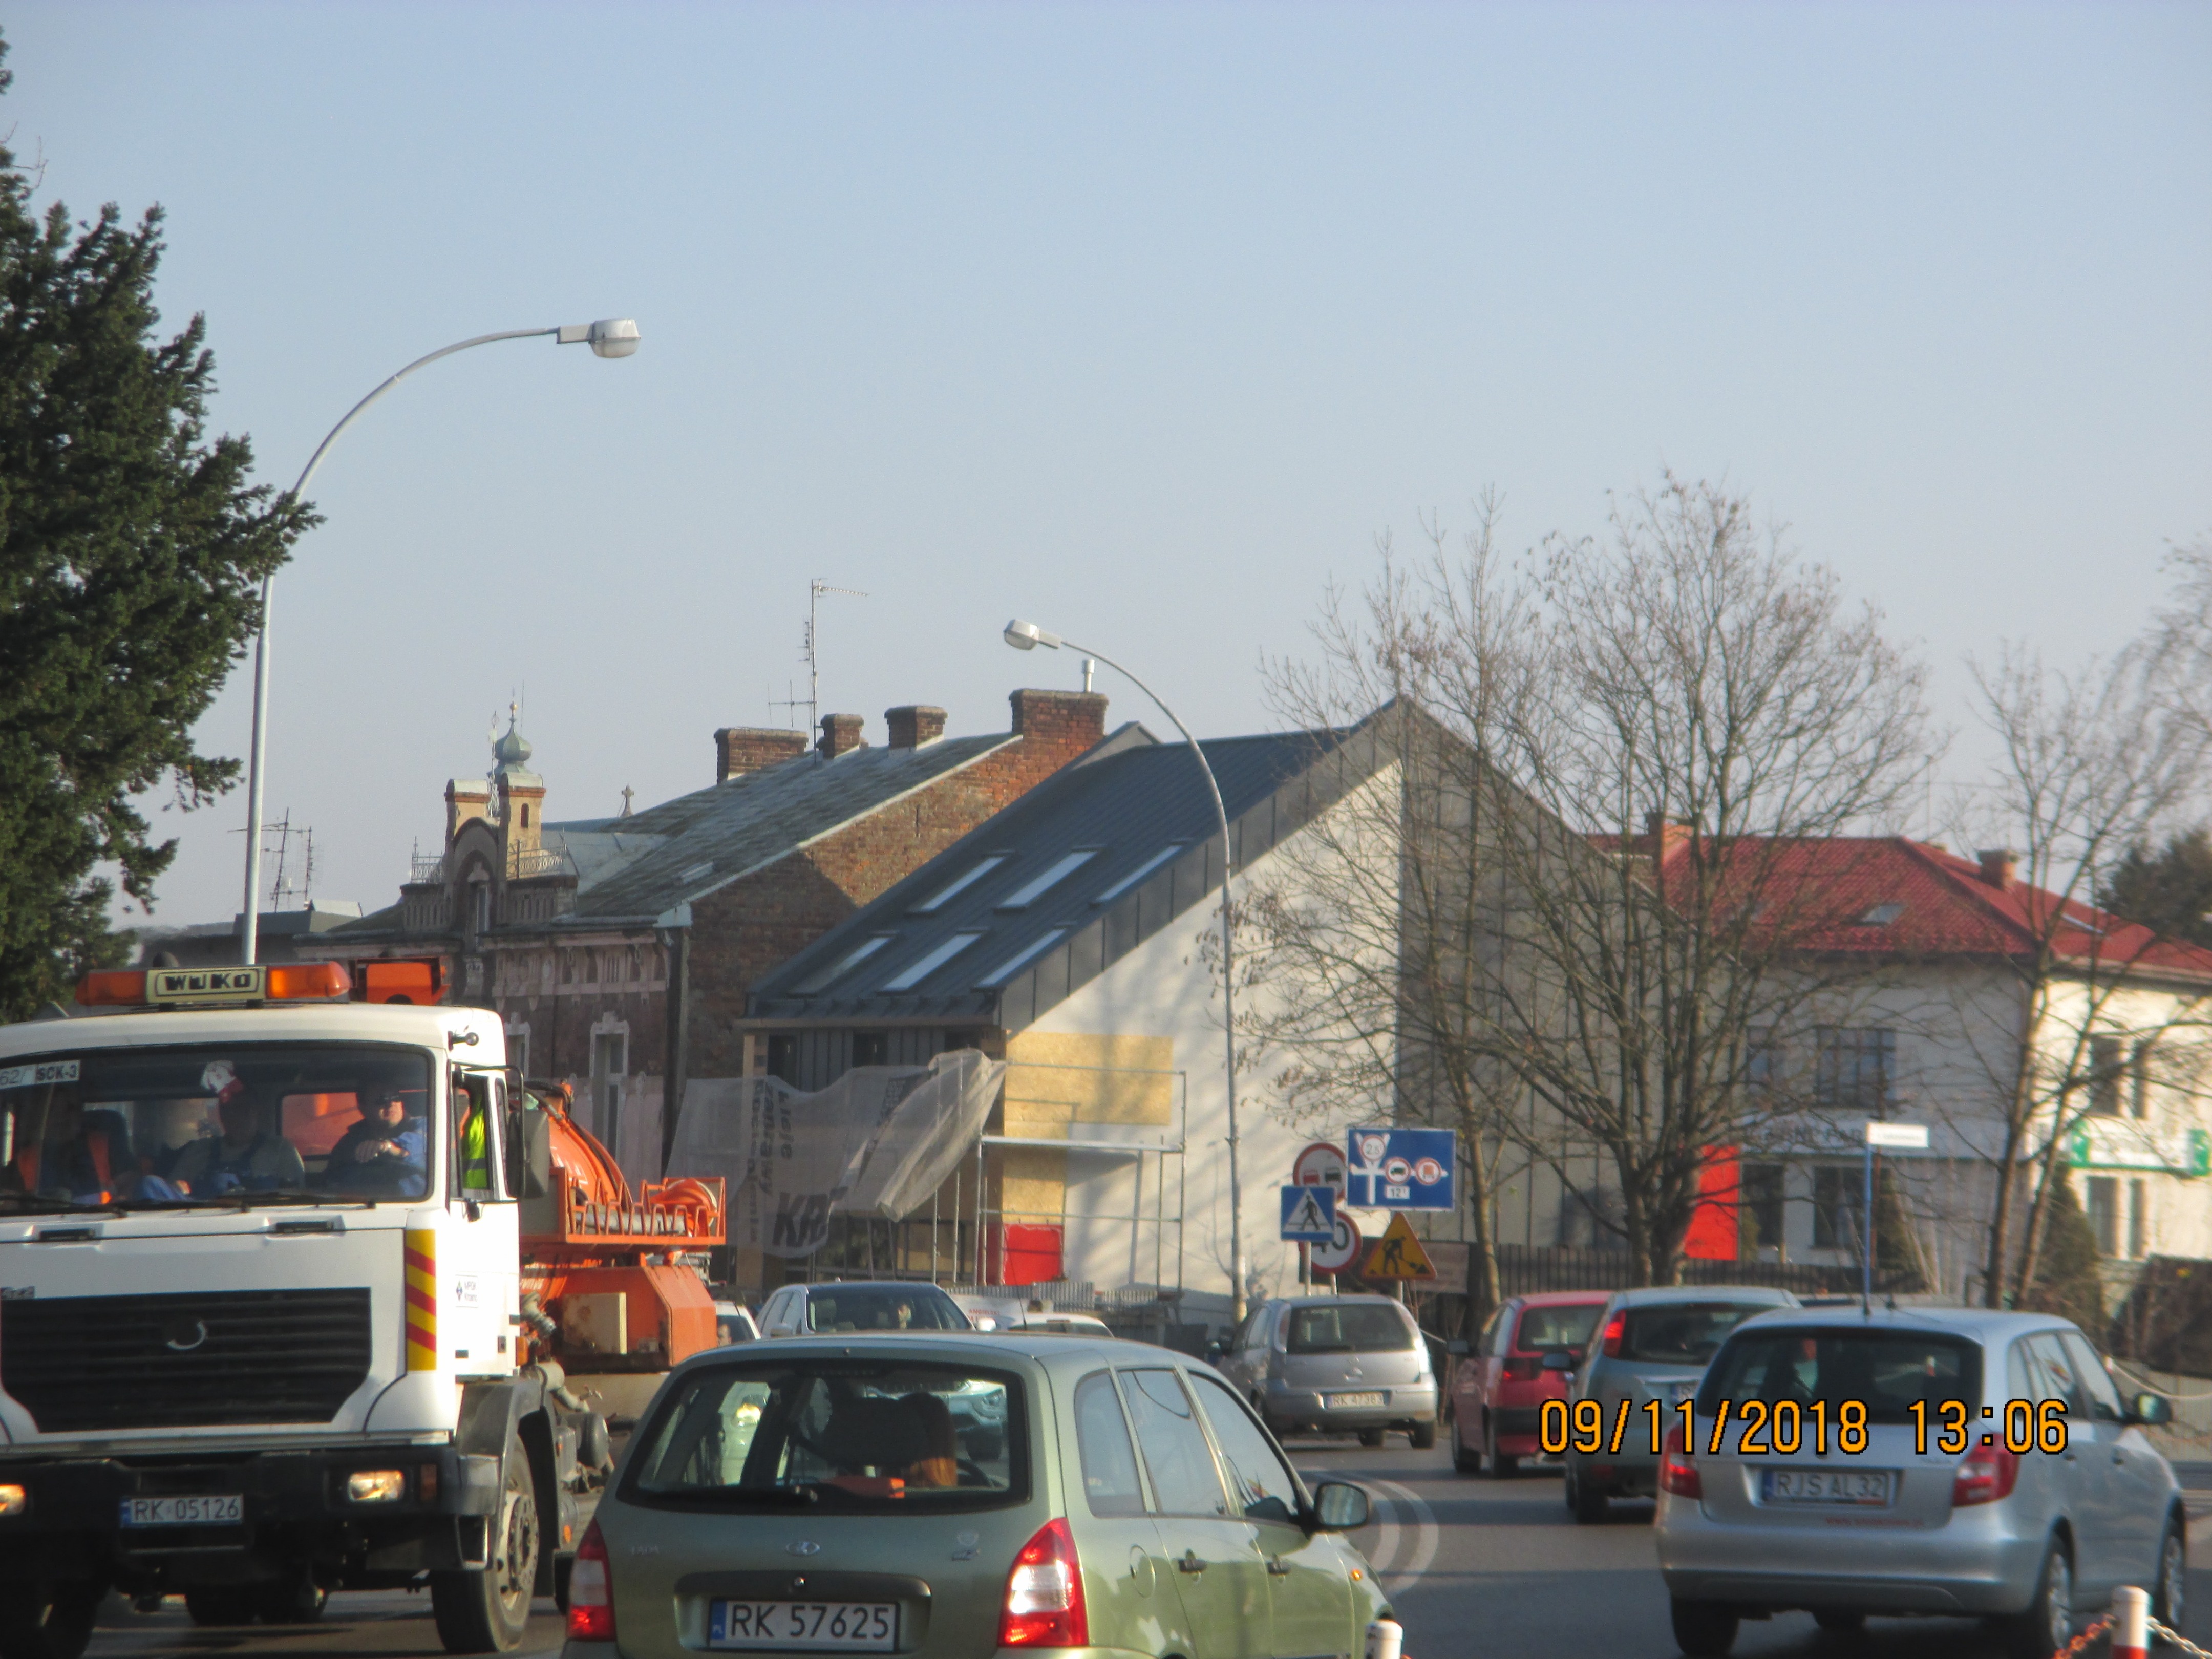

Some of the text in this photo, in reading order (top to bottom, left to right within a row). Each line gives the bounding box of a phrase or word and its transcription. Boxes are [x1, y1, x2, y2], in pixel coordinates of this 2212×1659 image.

[165, 973, 251, 990] WUKO
[1777, 1473, 1883, 1498] RJS AL32
[135, 1497, 239, 1521] RK 05126
[731, 1604, 889, 1639] RK 57625
